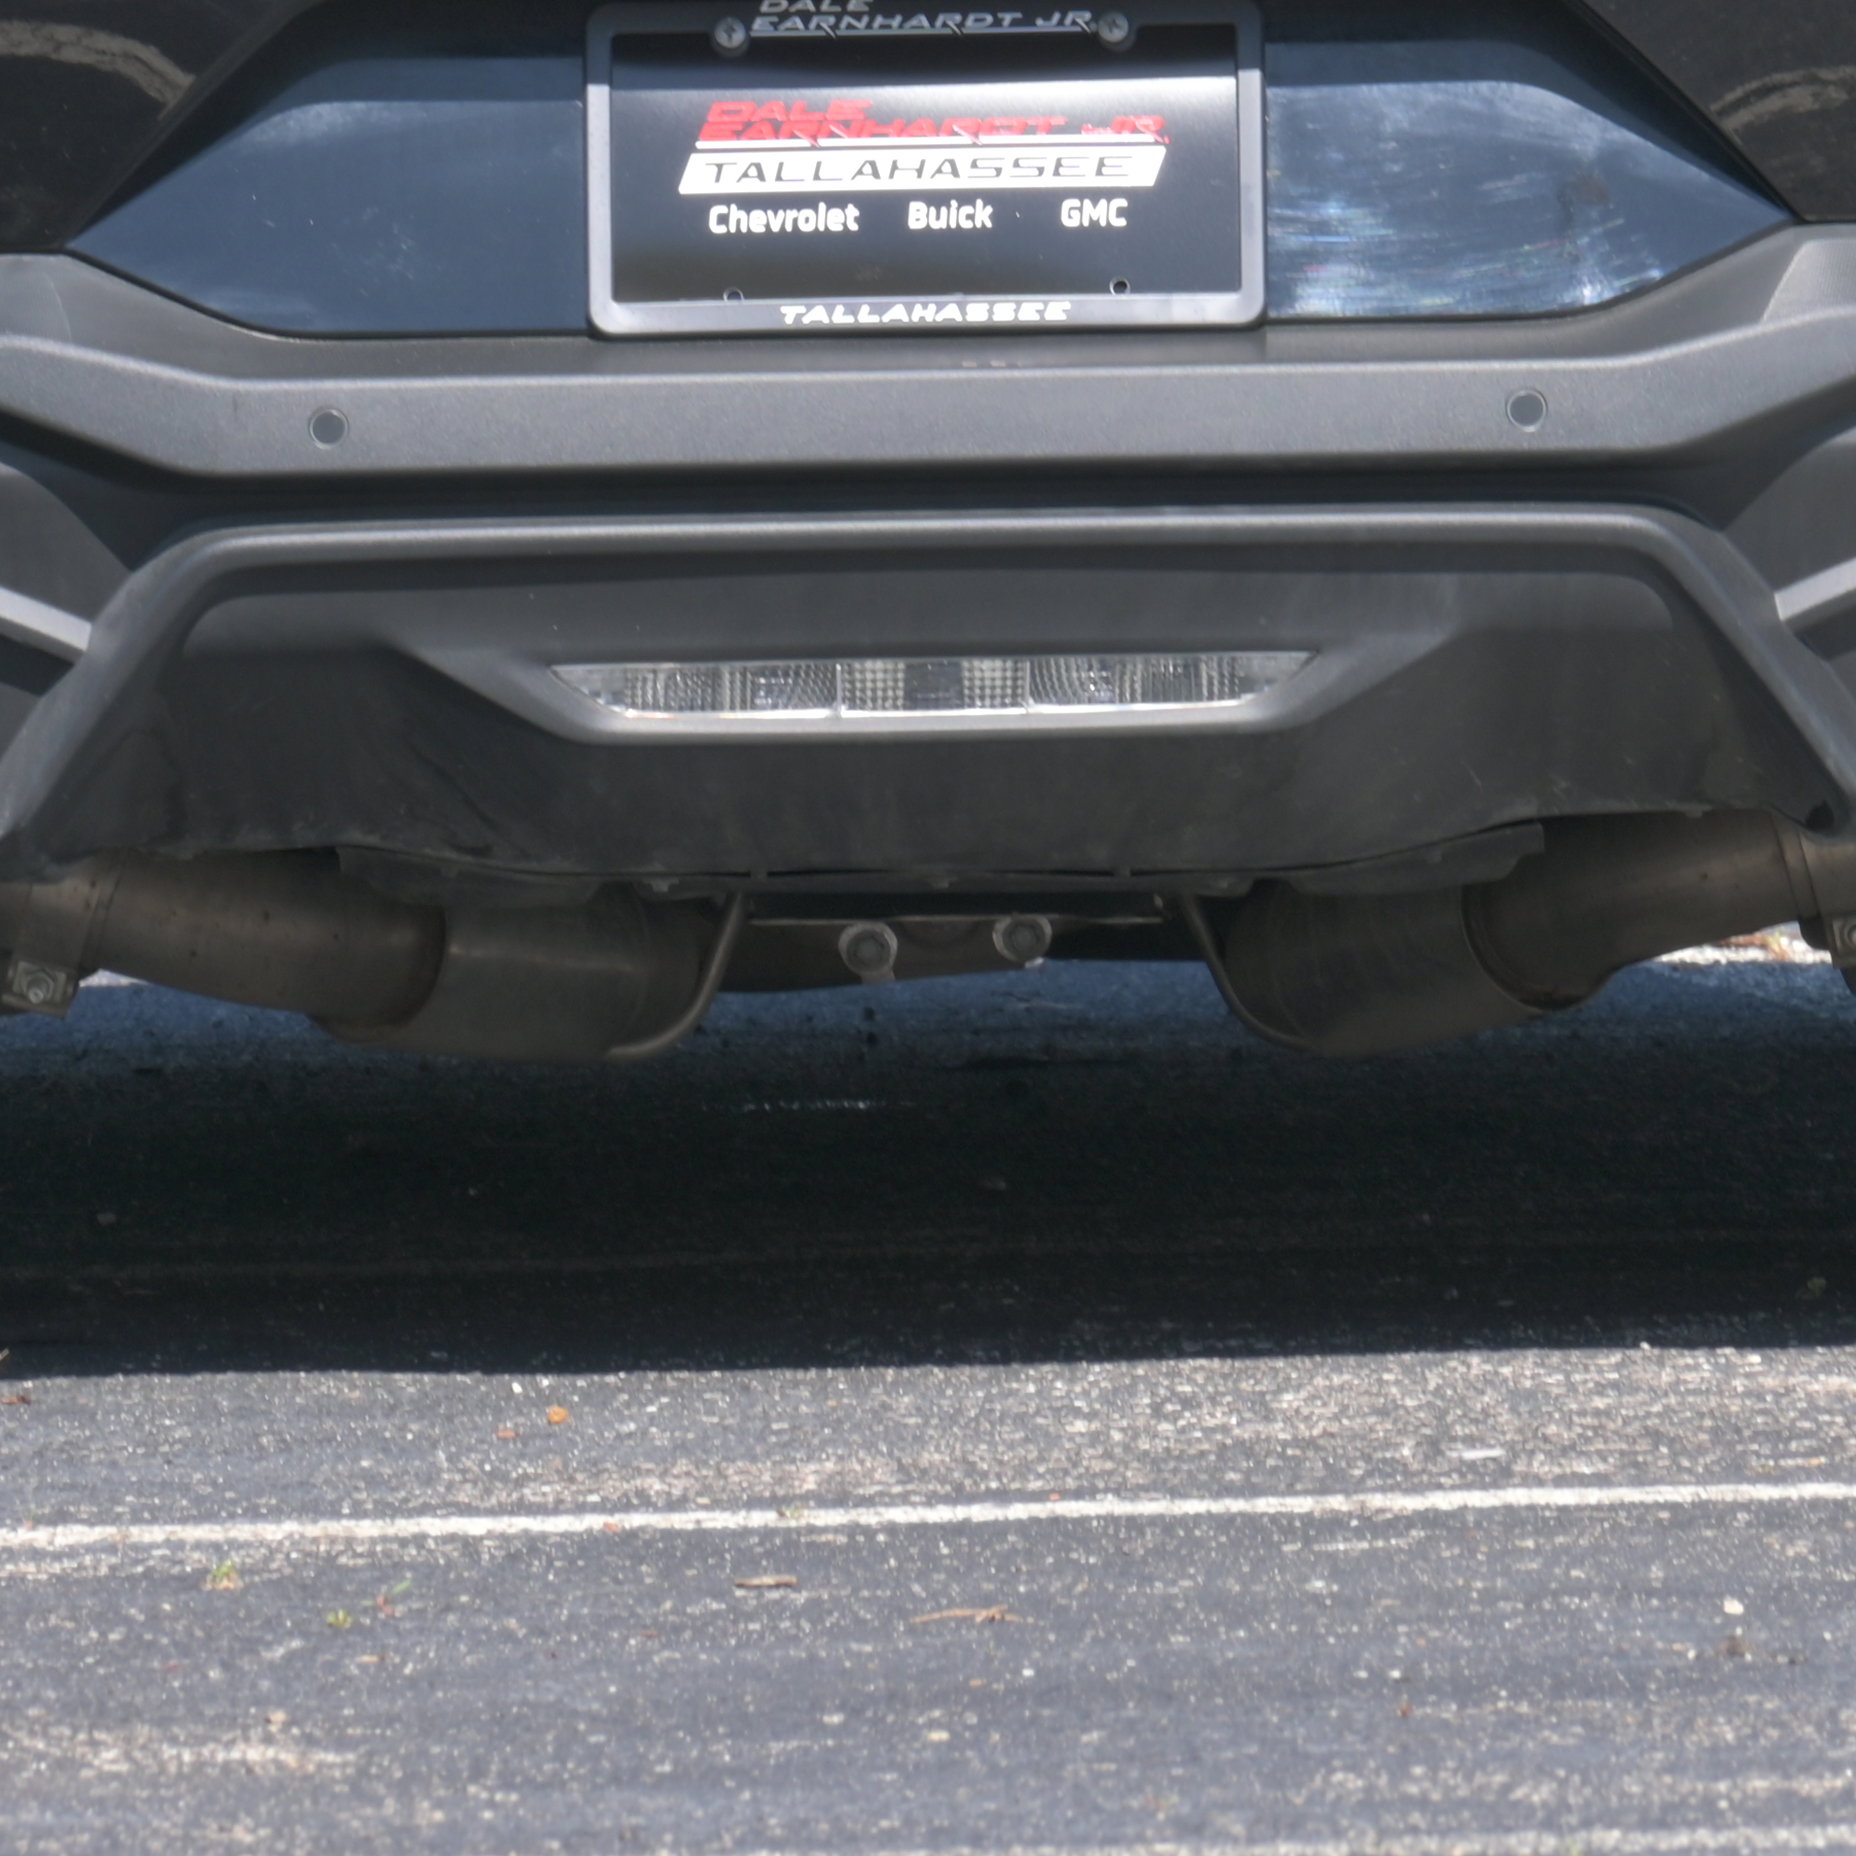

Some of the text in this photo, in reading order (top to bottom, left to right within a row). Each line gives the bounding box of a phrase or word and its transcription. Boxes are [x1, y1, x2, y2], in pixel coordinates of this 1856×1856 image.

[751, 12, 1023, 39] EARNHARDT
[707, 100, 873, 122] DALE
[699, 116, 1068, 147] EARNHARDT
[705, 156, 1133, 183] TALLAHASSEE
[708, 197, 1129, 234] Chevrolet Buick GMC
[780, 301, 1072, 325] TALLAHASSEE
